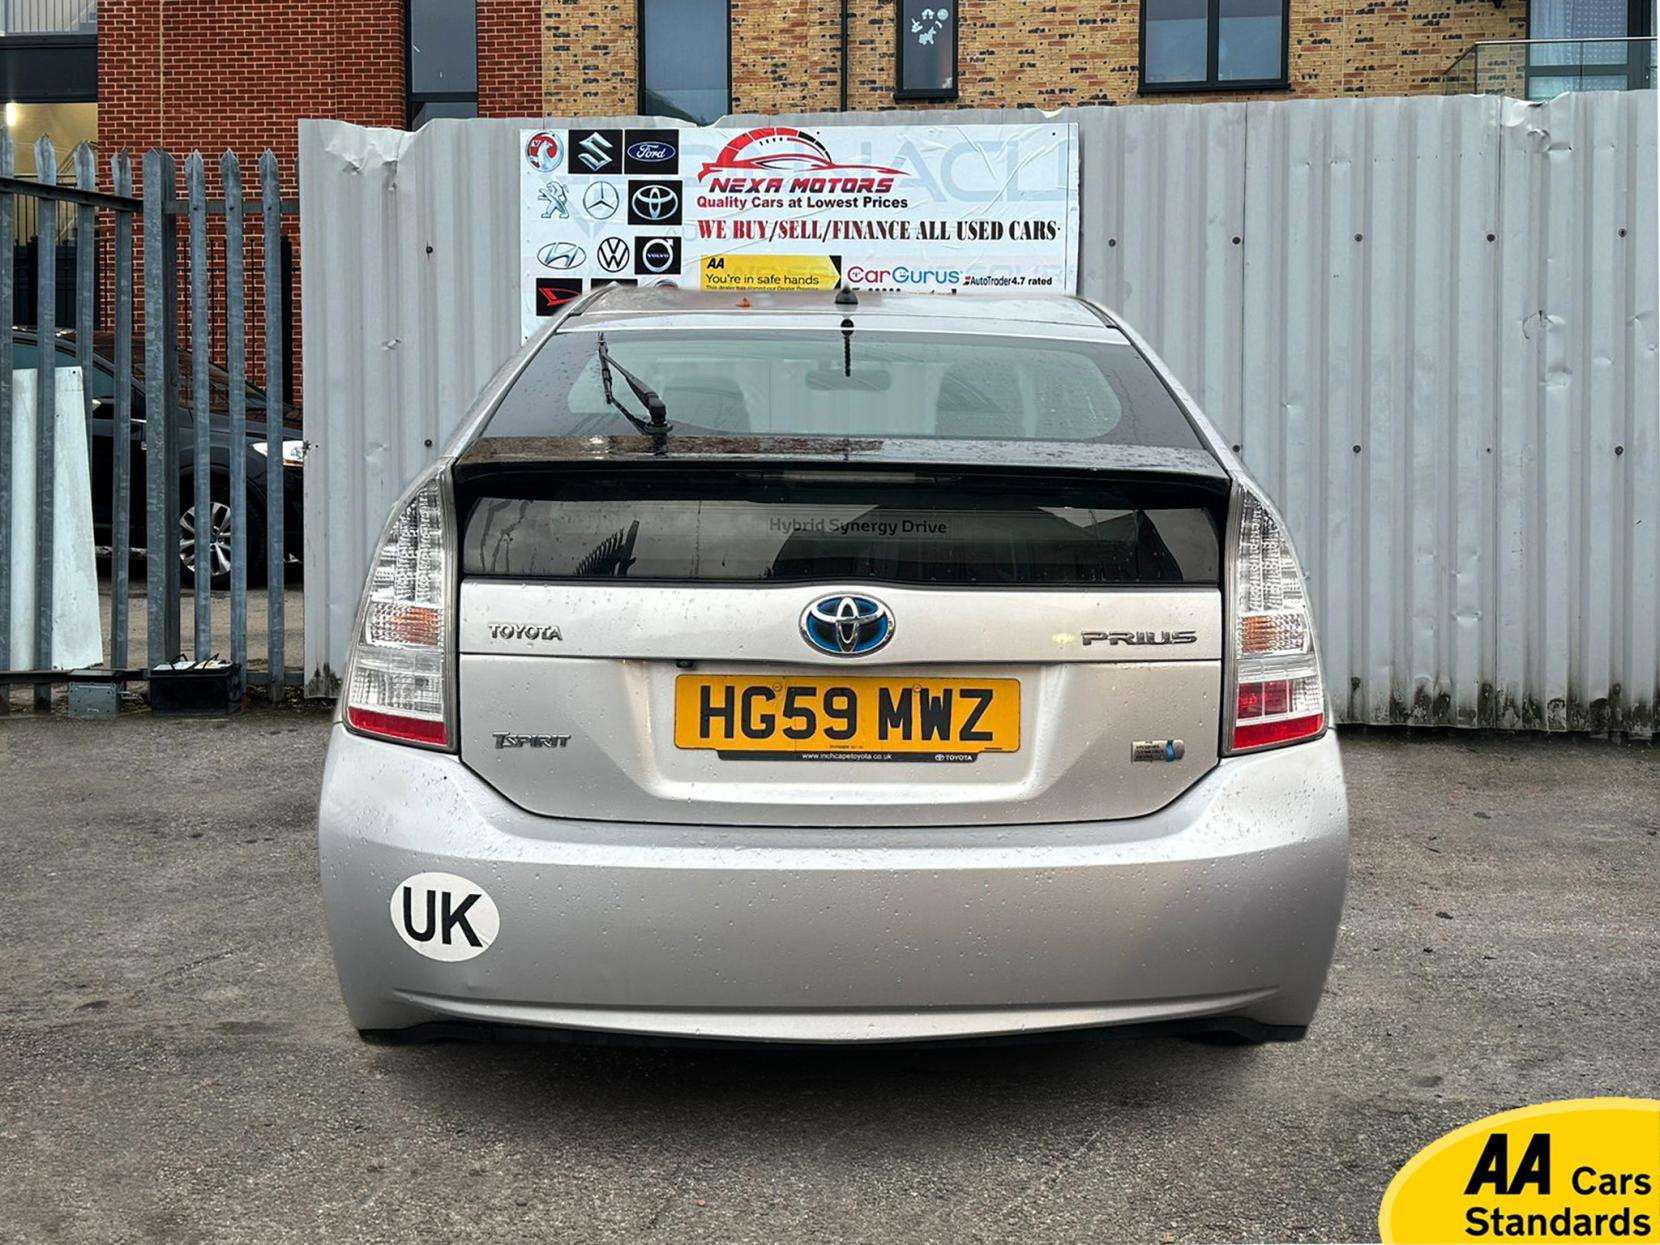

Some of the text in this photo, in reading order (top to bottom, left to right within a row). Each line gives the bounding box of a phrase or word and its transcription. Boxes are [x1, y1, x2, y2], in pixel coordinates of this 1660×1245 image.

[635, 143, 667, 159] Ford
[709, 178, 894, 194] NEXA MOTORS
[697, 196, 908, 209] Quality Cars at Lowest Prices
[697, 220, 727, 240] WE
[915, 221, 951, 240] ALL
[957, 220, 1004, 241] USED
[1008, 220, 1057, 241] CARS
[706, 258, 725, 269] AA
[706, 274, 819, 285] You're in safe hands
[847, 266, 960, 284] CarGurus
[1028, 277, 1053, 286] rated
[769, 518, 948, 536] Hybrid Synergy Drive
[489, 624, 563, 641] TOYOTA
[1081, 631, 1198, 646] PRIUS
[700, 686, 993, 741] HG59 MWZ
[945, 754, 973, 762] TOYOTA
[403, 886, 483, 948] UK
